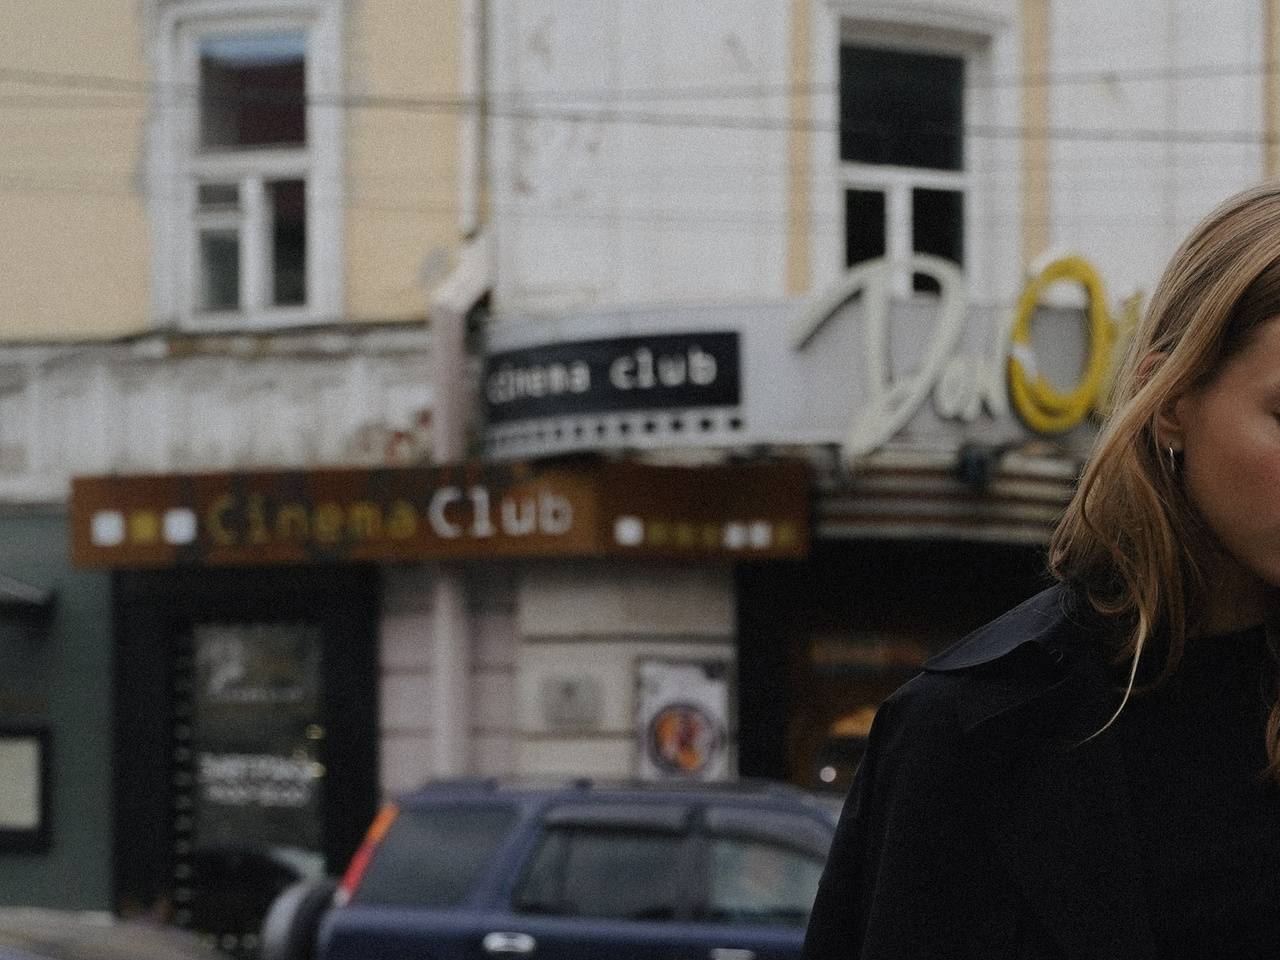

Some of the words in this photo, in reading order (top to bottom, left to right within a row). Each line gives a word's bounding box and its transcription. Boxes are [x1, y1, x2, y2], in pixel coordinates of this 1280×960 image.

[608, 346, 719, 391] club
[205, 493, 418, 546] Cinema
[426, 484, 574, 539] Club
